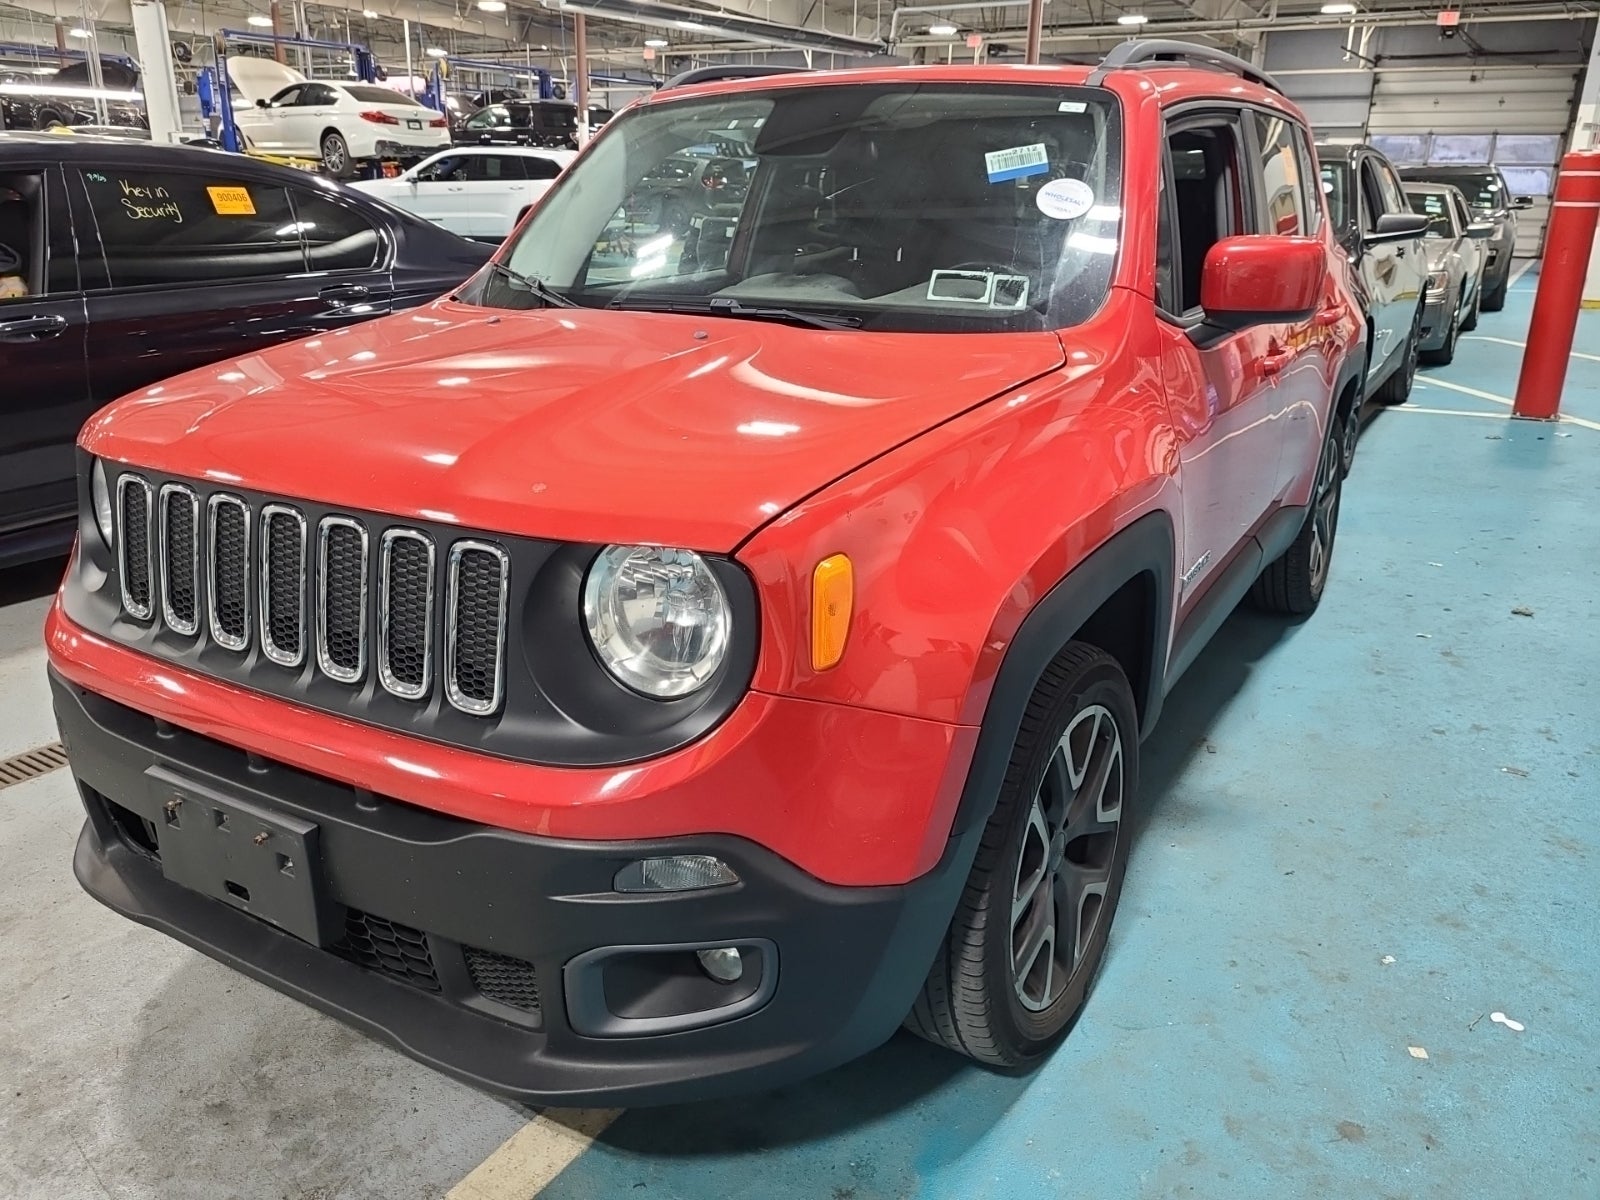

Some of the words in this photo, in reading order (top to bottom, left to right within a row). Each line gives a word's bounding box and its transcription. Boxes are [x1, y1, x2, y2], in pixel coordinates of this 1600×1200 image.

[118, 179, 153, 199] Key
[154, 186, 170, 199] in
[216, 192, 248, 202] 900406
[120, 198, 184, 224] Security
